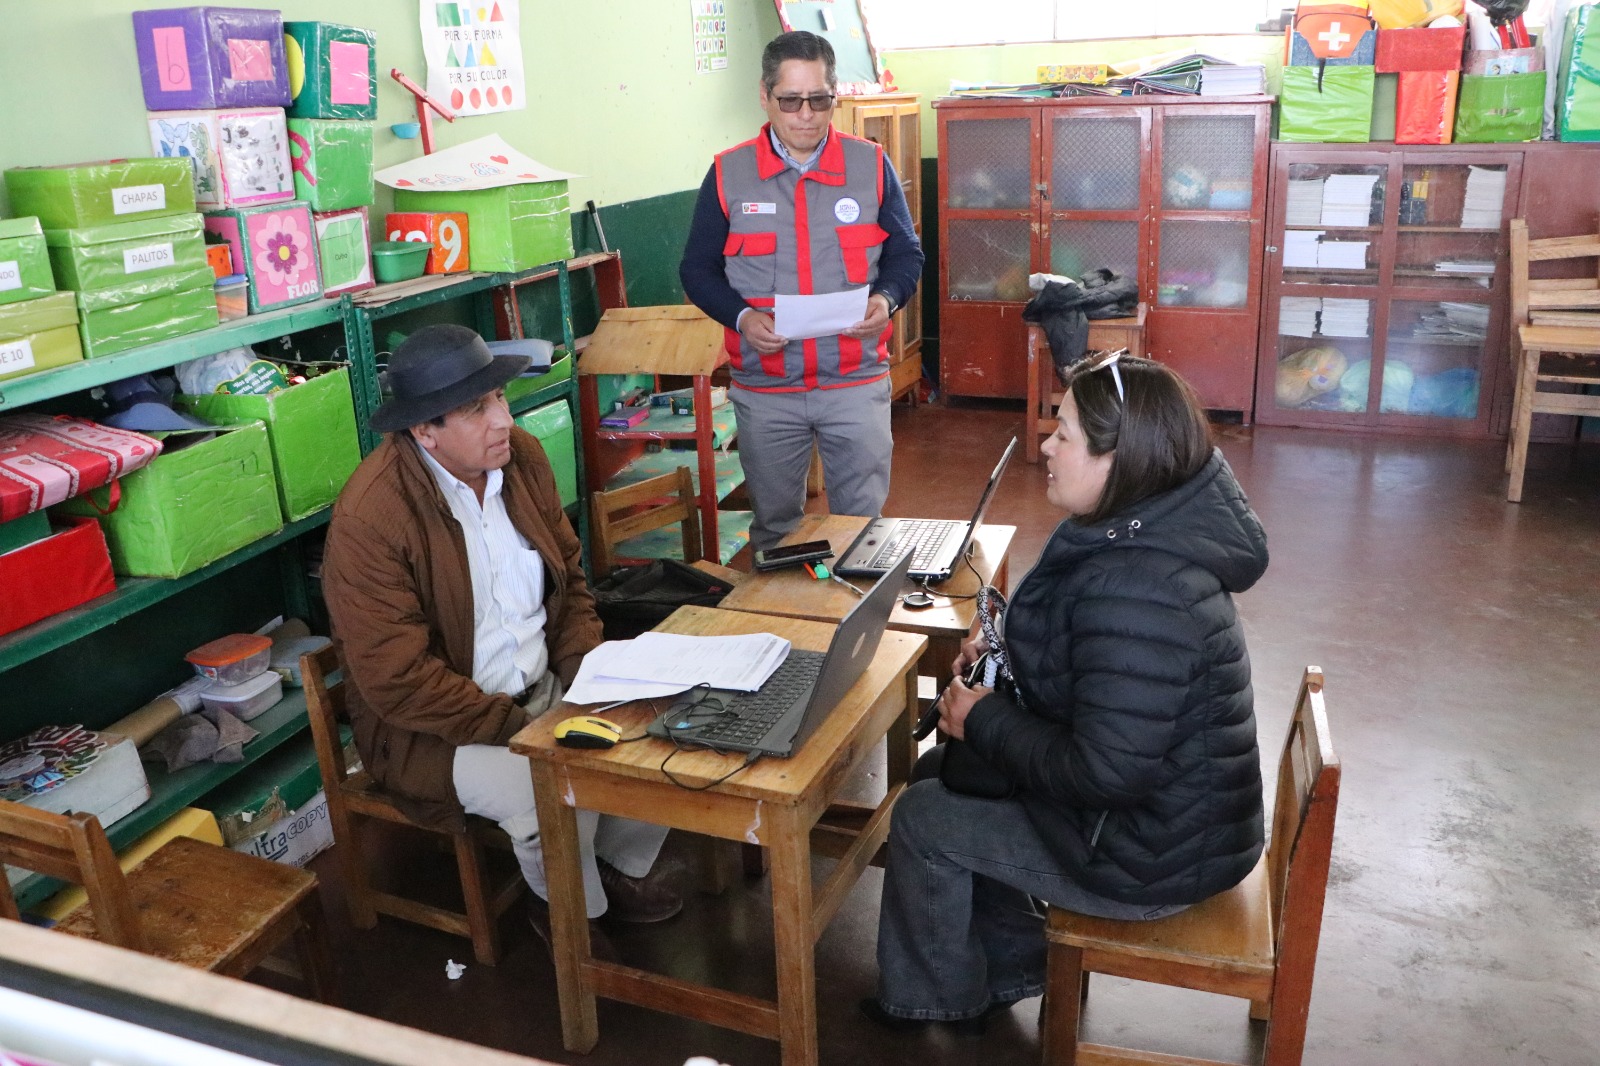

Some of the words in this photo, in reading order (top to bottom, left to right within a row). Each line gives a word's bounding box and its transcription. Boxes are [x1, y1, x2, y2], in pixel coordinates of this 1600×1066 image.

[444, 30, 461, 41] POR
[464, 30, 473, 41] SU
[474, 29, 503, 41] FORMA
[449, 72, 463, 84] POR
[466, 72, 478, 82] SU
[480, 69, 508, 81] COLOR
[121, 191, 158, 205] CHAPAS
[438, 218, 462, 272] 9
[131, 249, 169, 265] PALITOS
[286, 279, 319, 300] FLOR
[0, 352, 8, 365] E
[10, 348, 24, 362] 10
